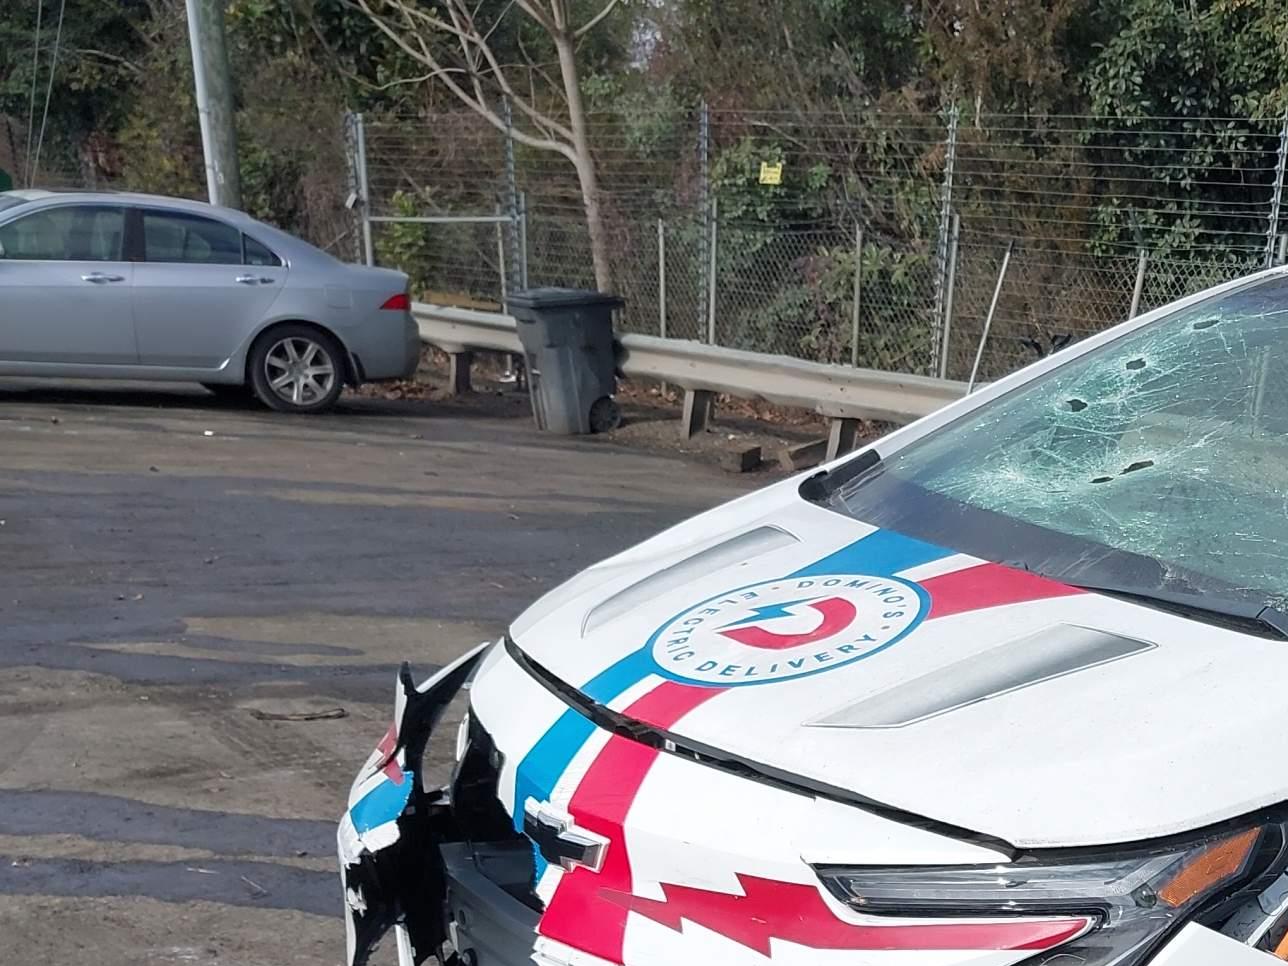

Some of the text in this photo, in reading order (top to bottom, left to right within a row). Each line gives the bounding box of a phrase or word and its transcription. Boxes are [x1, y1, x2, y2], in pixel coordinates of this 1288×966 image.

[797, 578, 907, 620] DOMINO'S
[666, 592, 880, 678] ELECTRIC DELIVERY
